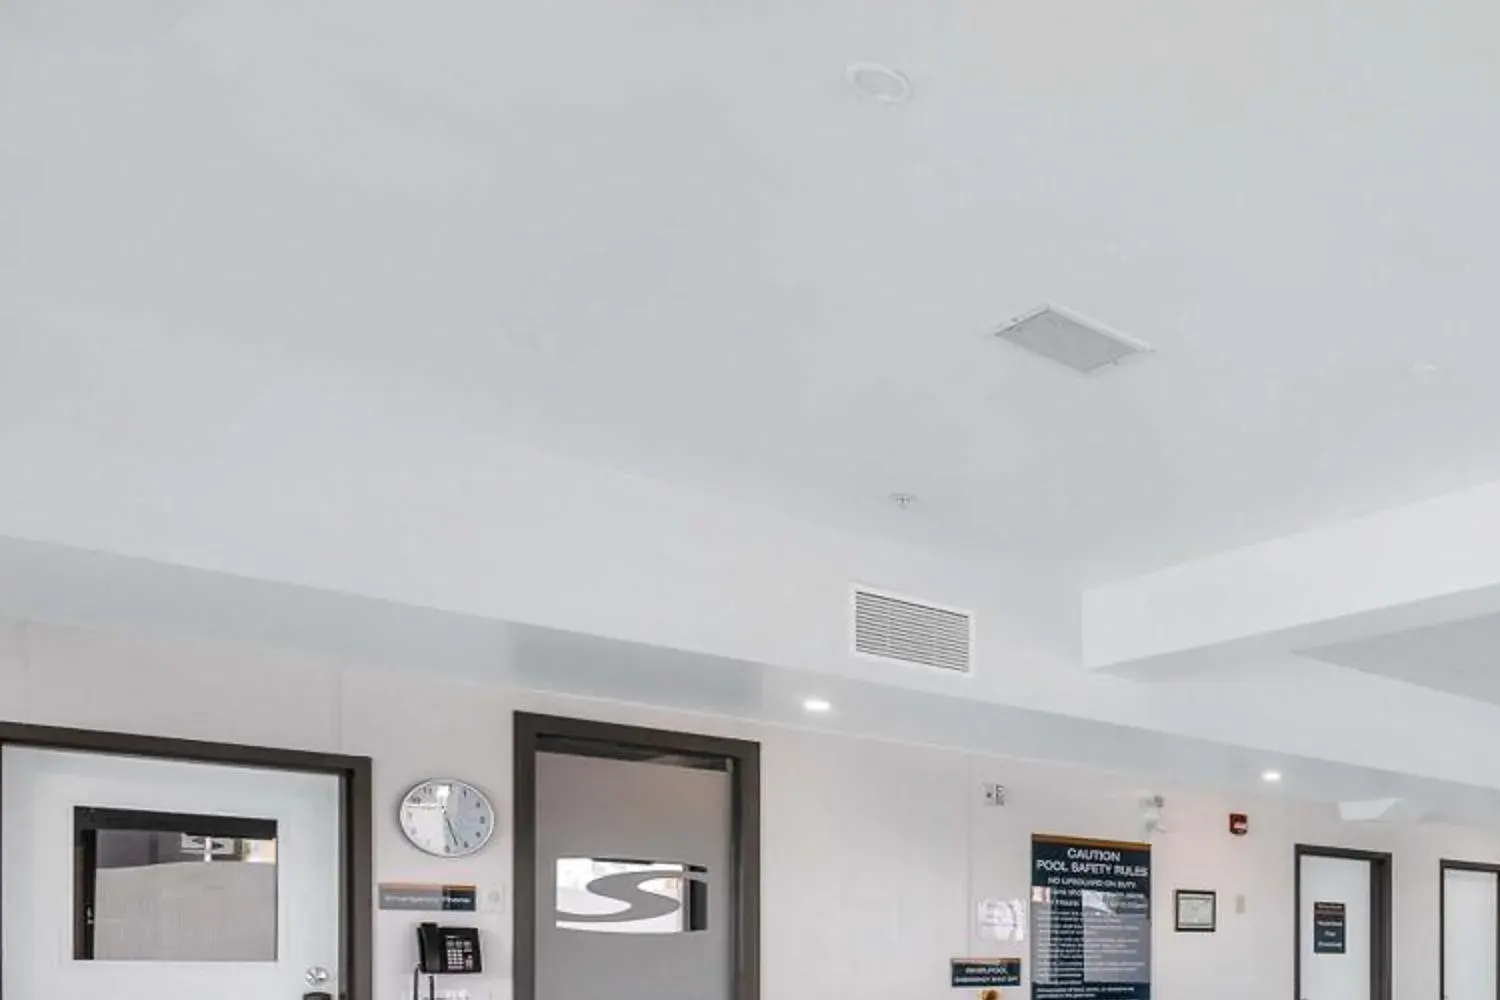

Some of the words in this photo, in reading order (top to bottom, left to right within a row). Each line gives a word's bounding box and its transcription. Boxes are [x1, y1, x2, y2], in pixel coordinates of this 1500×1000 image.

[1067, 847, 1120, 861] CAUTION
[1036, 859, 1068, 872] POOL
[1071, 861, 1112, 875] SAFETY
[1113, 865, 1149, 877] RULES
